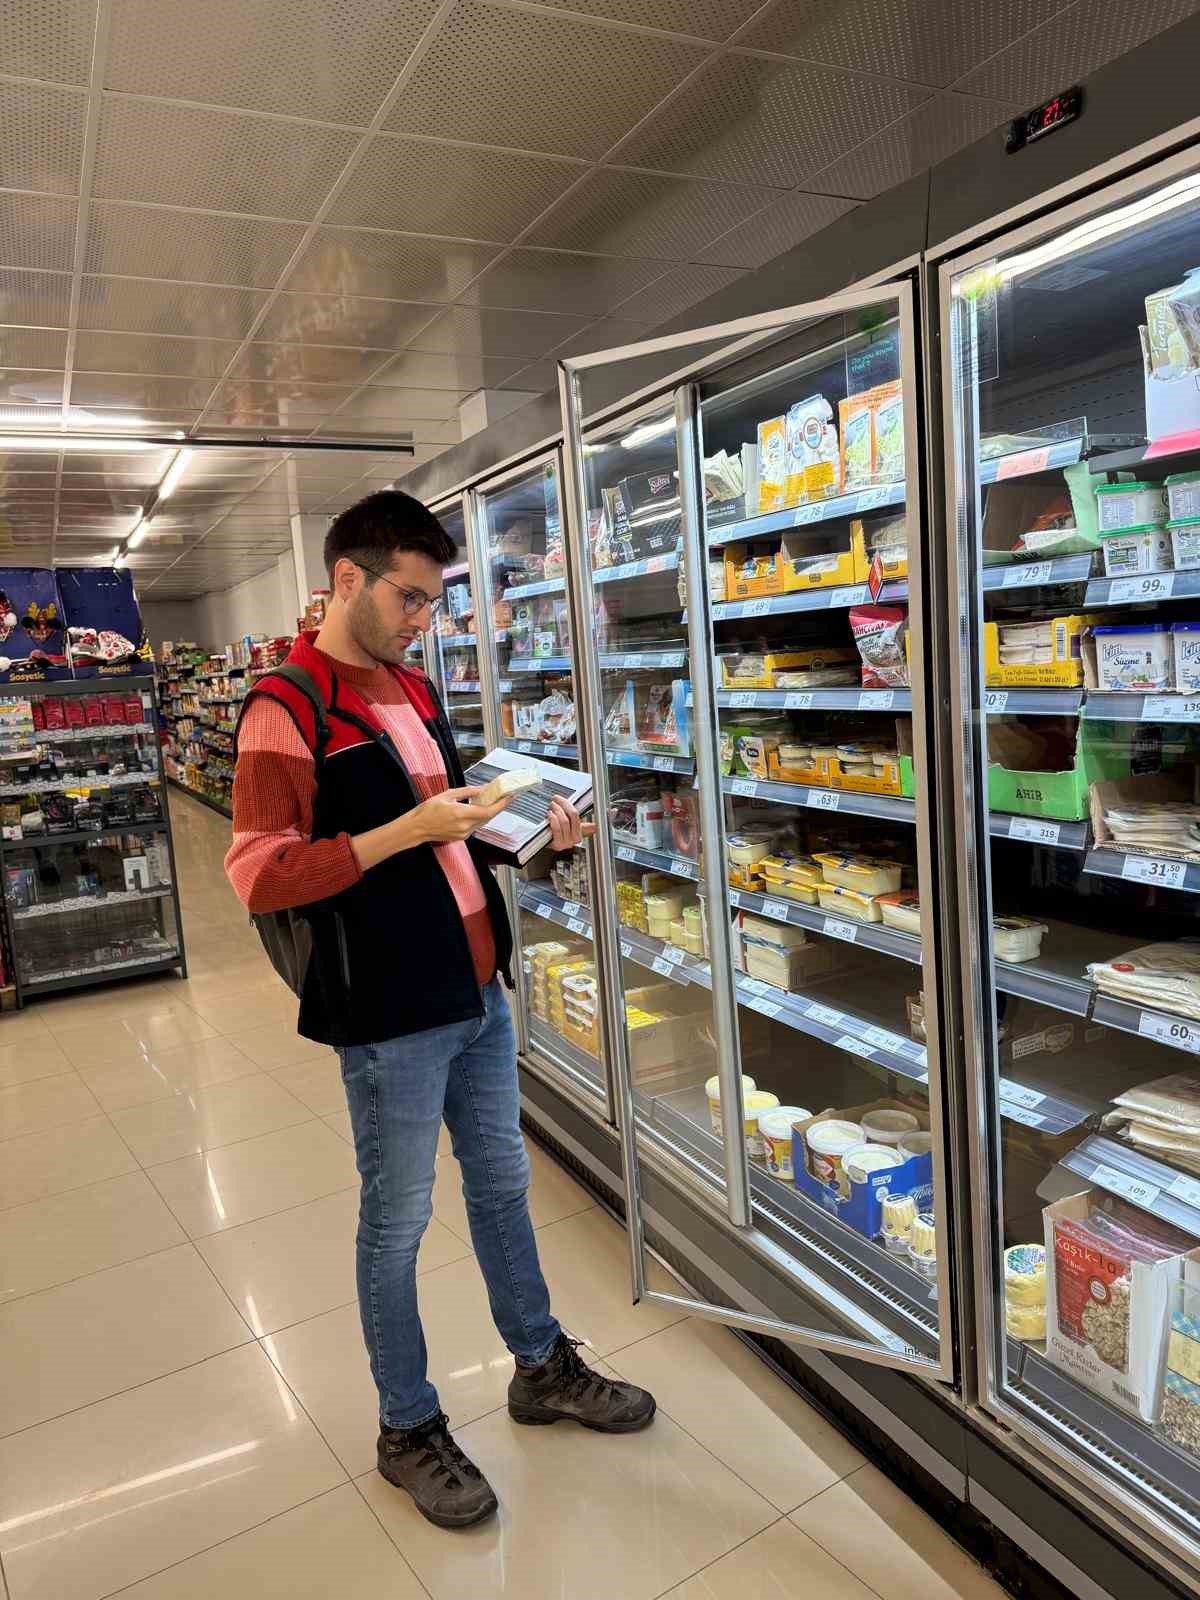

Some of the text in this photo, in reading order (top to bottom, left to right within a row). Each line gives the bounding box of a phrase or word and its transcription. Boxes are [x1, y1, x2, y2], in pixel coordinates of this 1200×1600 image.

[1142, 579, 1161, 593] 99
[1113, 655, 1140, 666] Süzme
[1169, 1023, 1189, 1040] 60
